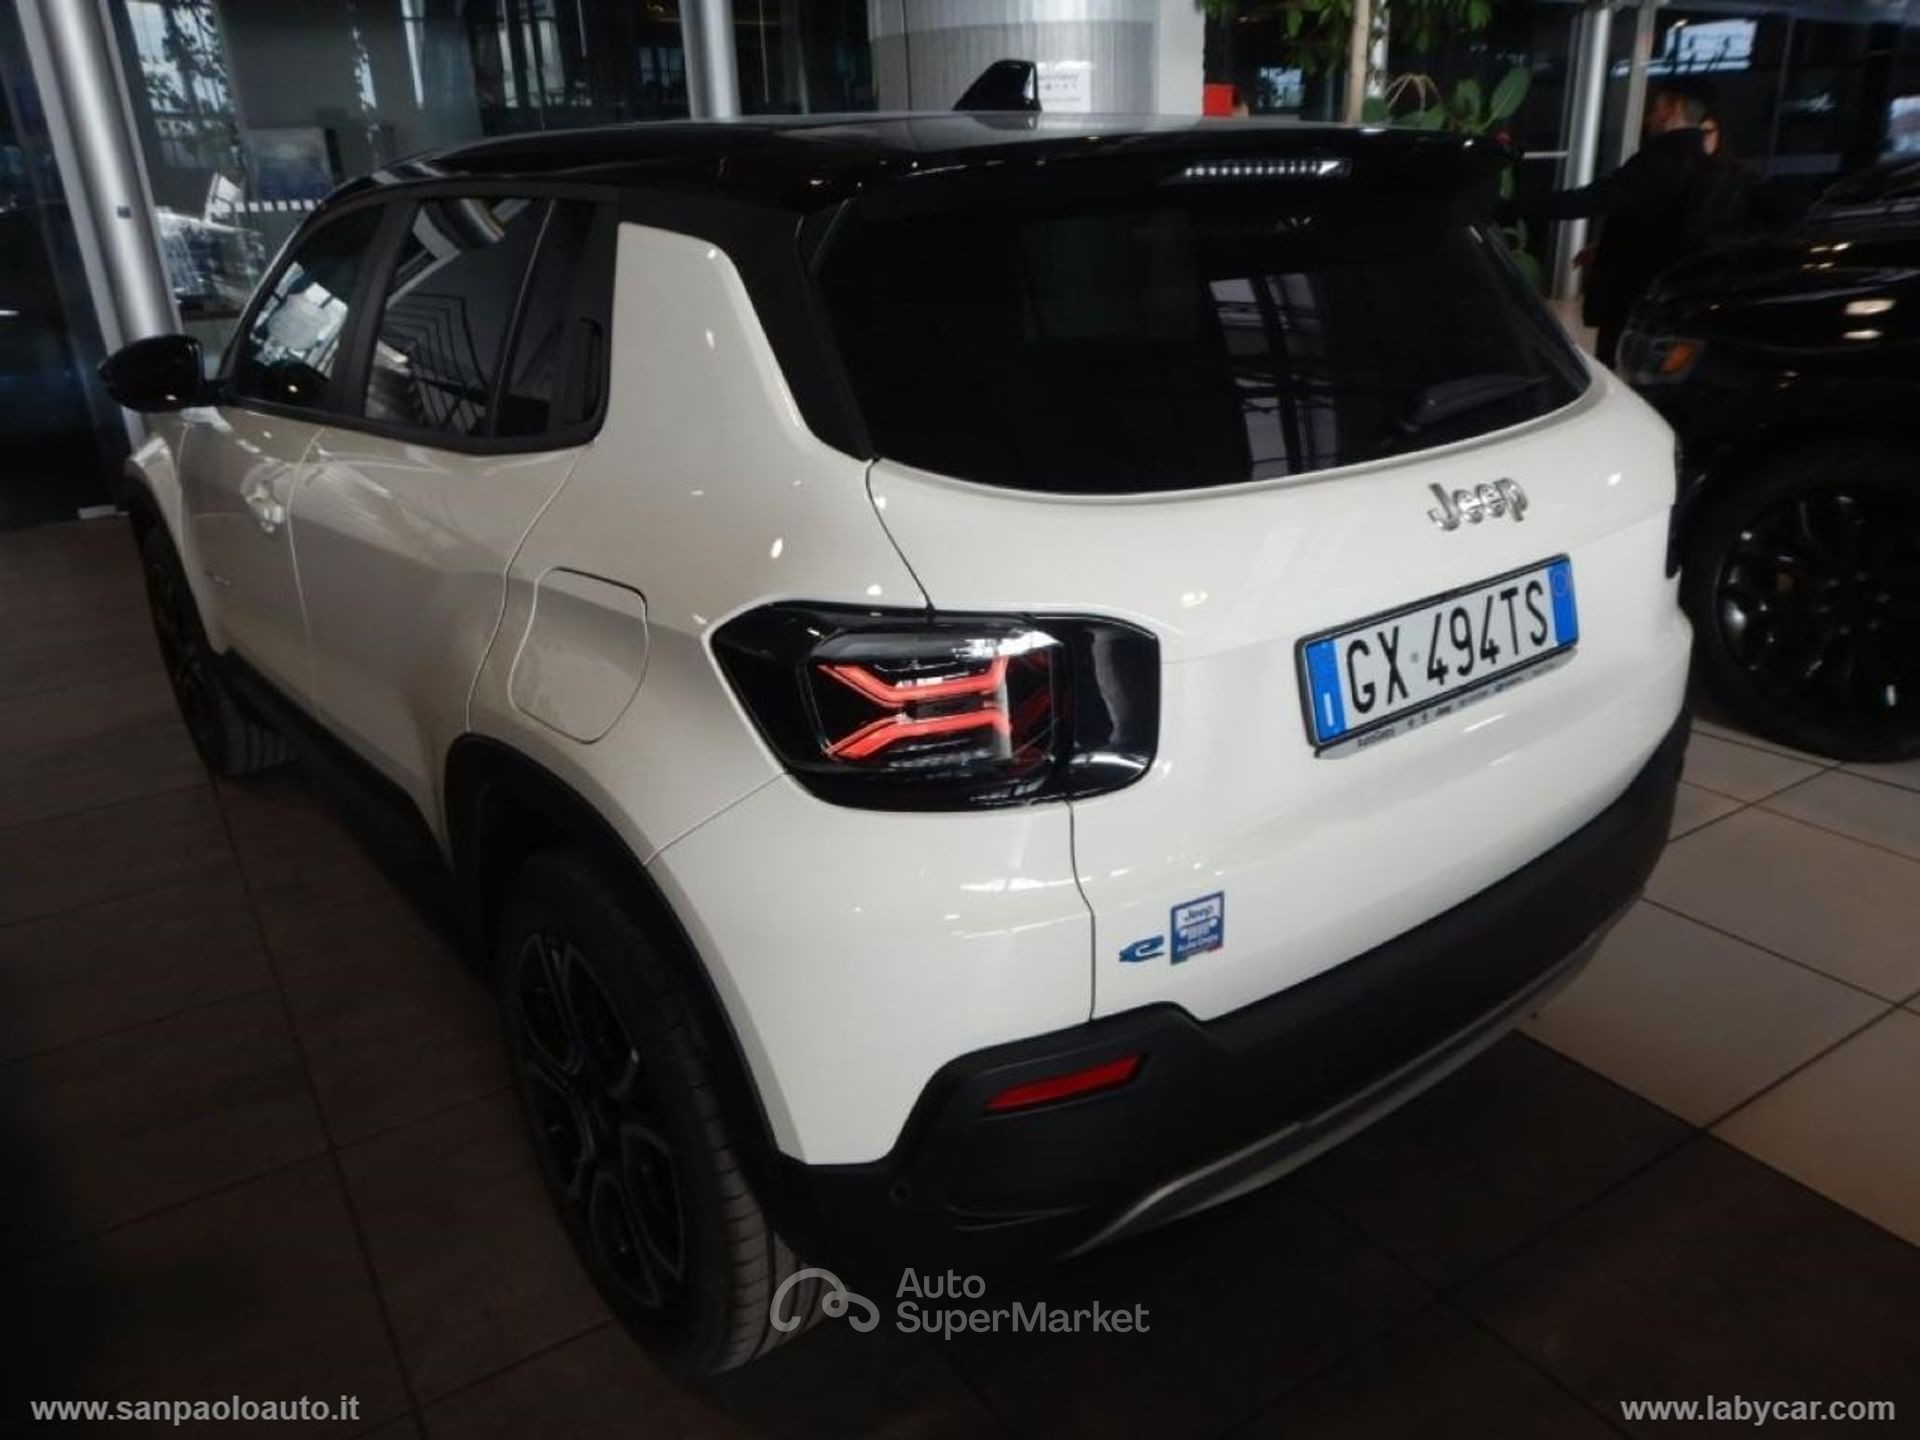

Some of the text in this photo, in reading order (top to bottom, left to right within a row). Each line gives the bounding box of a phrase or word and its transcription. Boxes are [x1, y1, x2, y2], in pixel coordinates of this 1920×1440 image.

[1427, 478, 1529, 531] Jeep
[1346, 579, 1549, 713] GX 494TS
